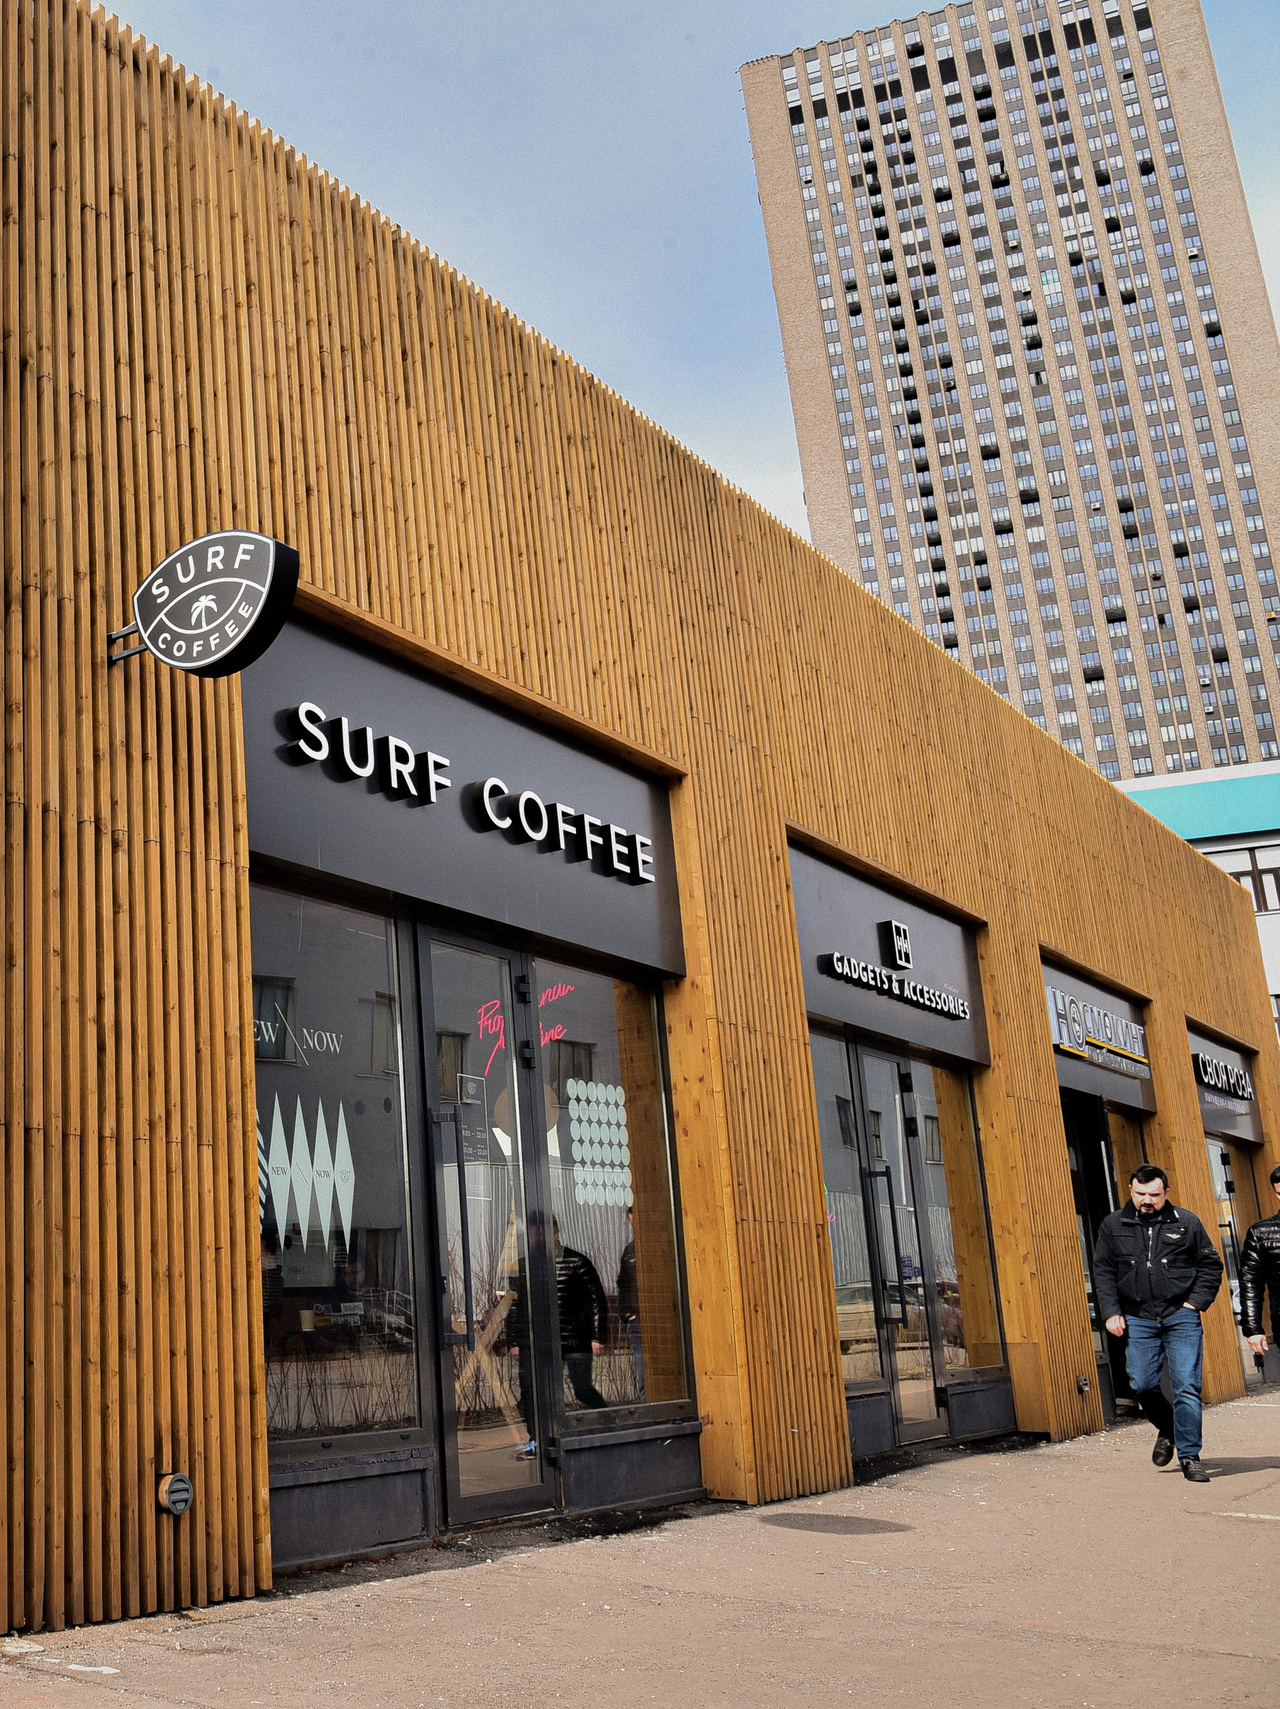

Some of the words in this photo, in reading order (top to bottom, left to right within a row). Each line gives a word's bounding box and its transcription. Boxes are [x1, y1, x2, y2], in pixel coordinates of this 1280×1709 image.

[151, 543, 255, 604] SURF
[157, 601, 253, 657] COFFEE
[297, 701, 452, 803] SURF
[482, 777, 656, 882] COFFEE
[833, 951, 889, 990] GADGETS
[891, 973, 900, 995] &
[904, 978, 970, 1020] ACCESSORIES
[253, 1019, 280, 1044] EW
[302, 1028, 343, 1054] NOW
[1199, 1052, 1229, 1091] СВОЯ
[1227, 1064, 1255, 1100] РОЗА
[271, 1166, 288, 1176] NEW
[315, 1169, 331, 1179] NOW
